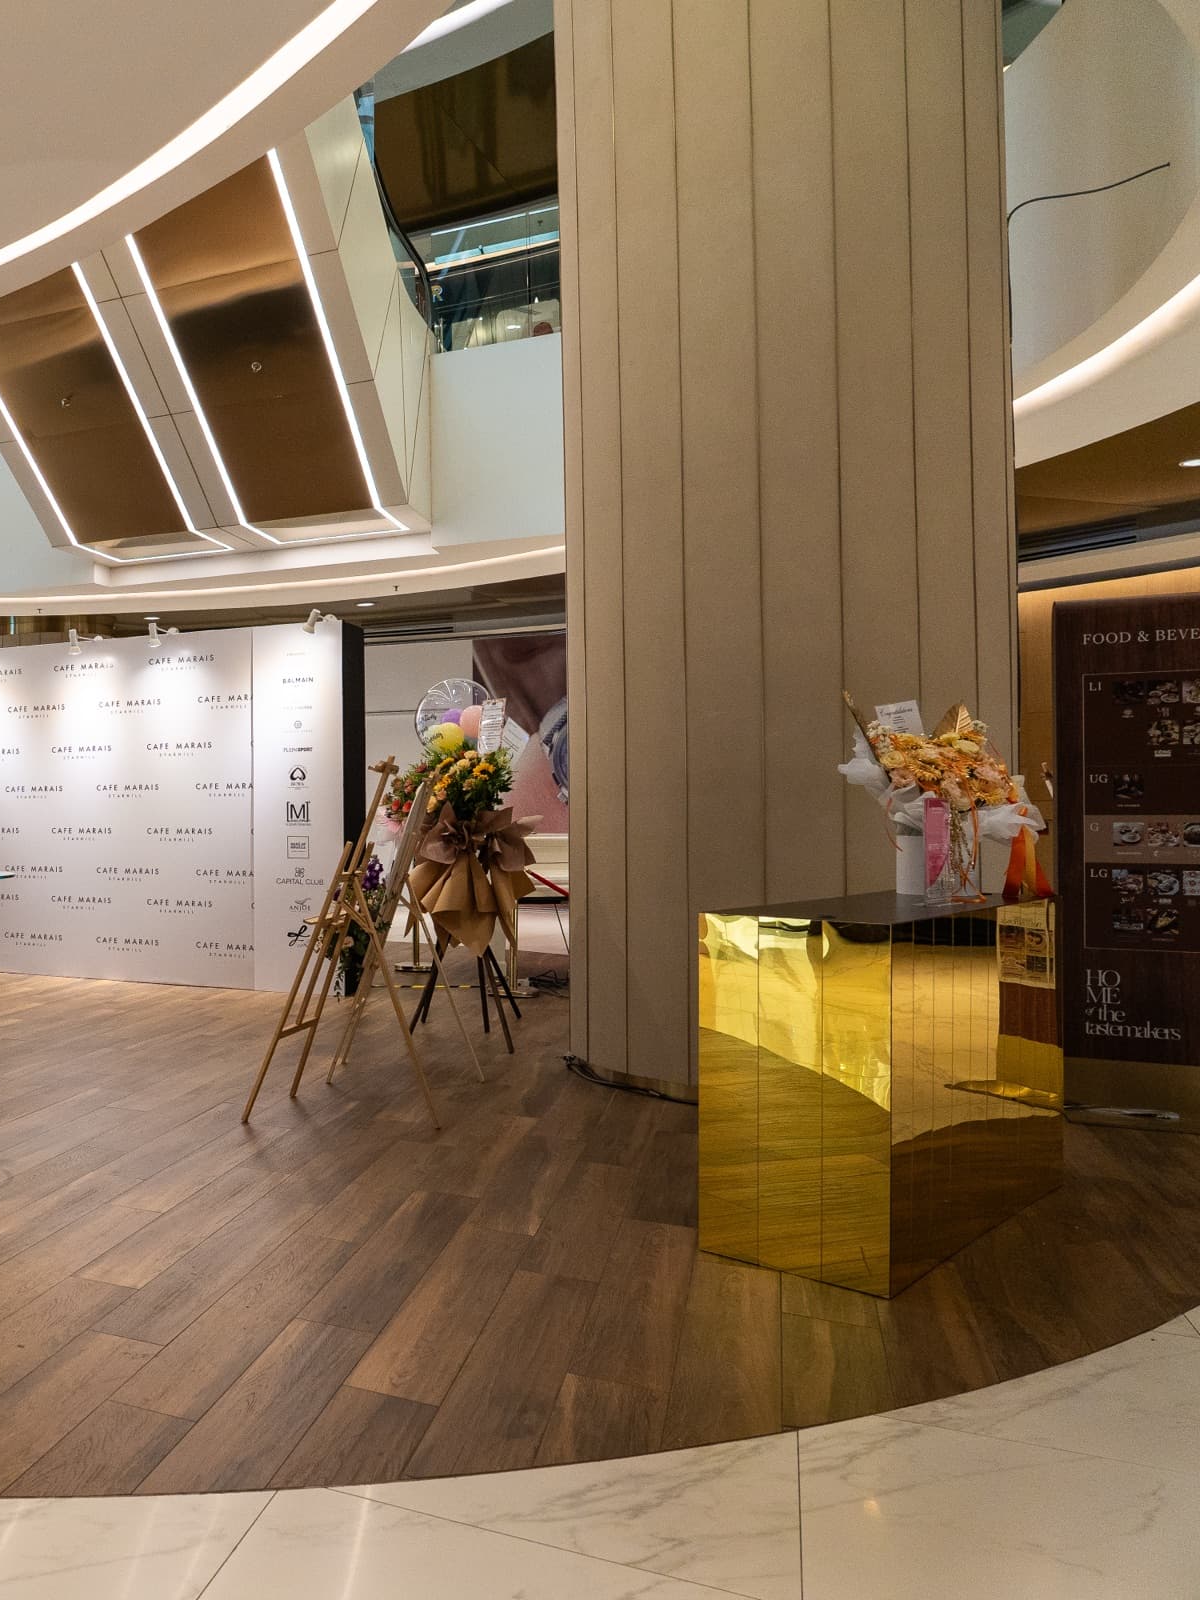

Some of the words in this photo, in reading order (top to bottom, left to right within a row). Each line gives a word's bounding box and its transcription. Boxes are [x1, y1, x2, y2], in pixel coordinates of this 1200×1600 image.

[1083, 632, 1131, 645] FOOD
[1138, 630, 1149, 641] &
[148, 657, 172, 666] CAFE
[178, 654, 215, 664] MARAIS
[53, 663, 75, 673] CAFE
[282, 676, 314, 685] BALMAIN
[98, 700, 120, 709] CAFE
[126, 698, 161, 707] MARAIS
[197, 695, 222, 705] CAFE
[7, 705, 28, 714] CAFE
[33, 703, 65, 712] MARAIS
[51, 746, 73, 754] CAFE
[78, 745, 112, 753] MARAIS
[146, 742, 169, 751] CAFE
[176, 741, 213, 750] MARAIS
[1089, 774, 1108, 784] UG
[5, 785, 25, 793] CAFE
[30, 785, 64, 793] MARAIS
[96, 784, 119, 792] CAFE
[124, 784, 160, 792] MARAIS
[195, 783, 219, 791] CAFE
[51, 827, 73, 835] CAFE
[78, 827, 112, 835] MARAIS
[146, 827, 169, 835] CAFE
[176, 827, 213, 835] MARAIS
[1089, 822, 1099, 832] G
[5, 864, 25, 873] CAFE
[30, 865, 64, 873] MARAIS
[96, 867, 119, 875] CAFE
[124, 868, 160, 876] MARAIS
[195, 869, 219, 877] CAFE
[1090, 869, 1108, 879] LG
[51, 895, 73, 904] CAFE
[78, 896, 112, 904] MARAIS
[146, 898, 169, 907] CAFE
[176, 900, 213, 908] MARAIS
[4, 932, 25, 940] CAFE
[30, 933, 63, 941] MARAIS
[96, 936, 118, 945] CAFE
[124, 938, 160, 946] MARAIS
[195, 941, 220, 950] CAFE
[1086, 969, 1121, 987] HO
[1086, 986, 1121, 1004] ME
[1098, 1004, 1126, 1022] the
[1085, 1020, 1181, 1041] tastemakers
